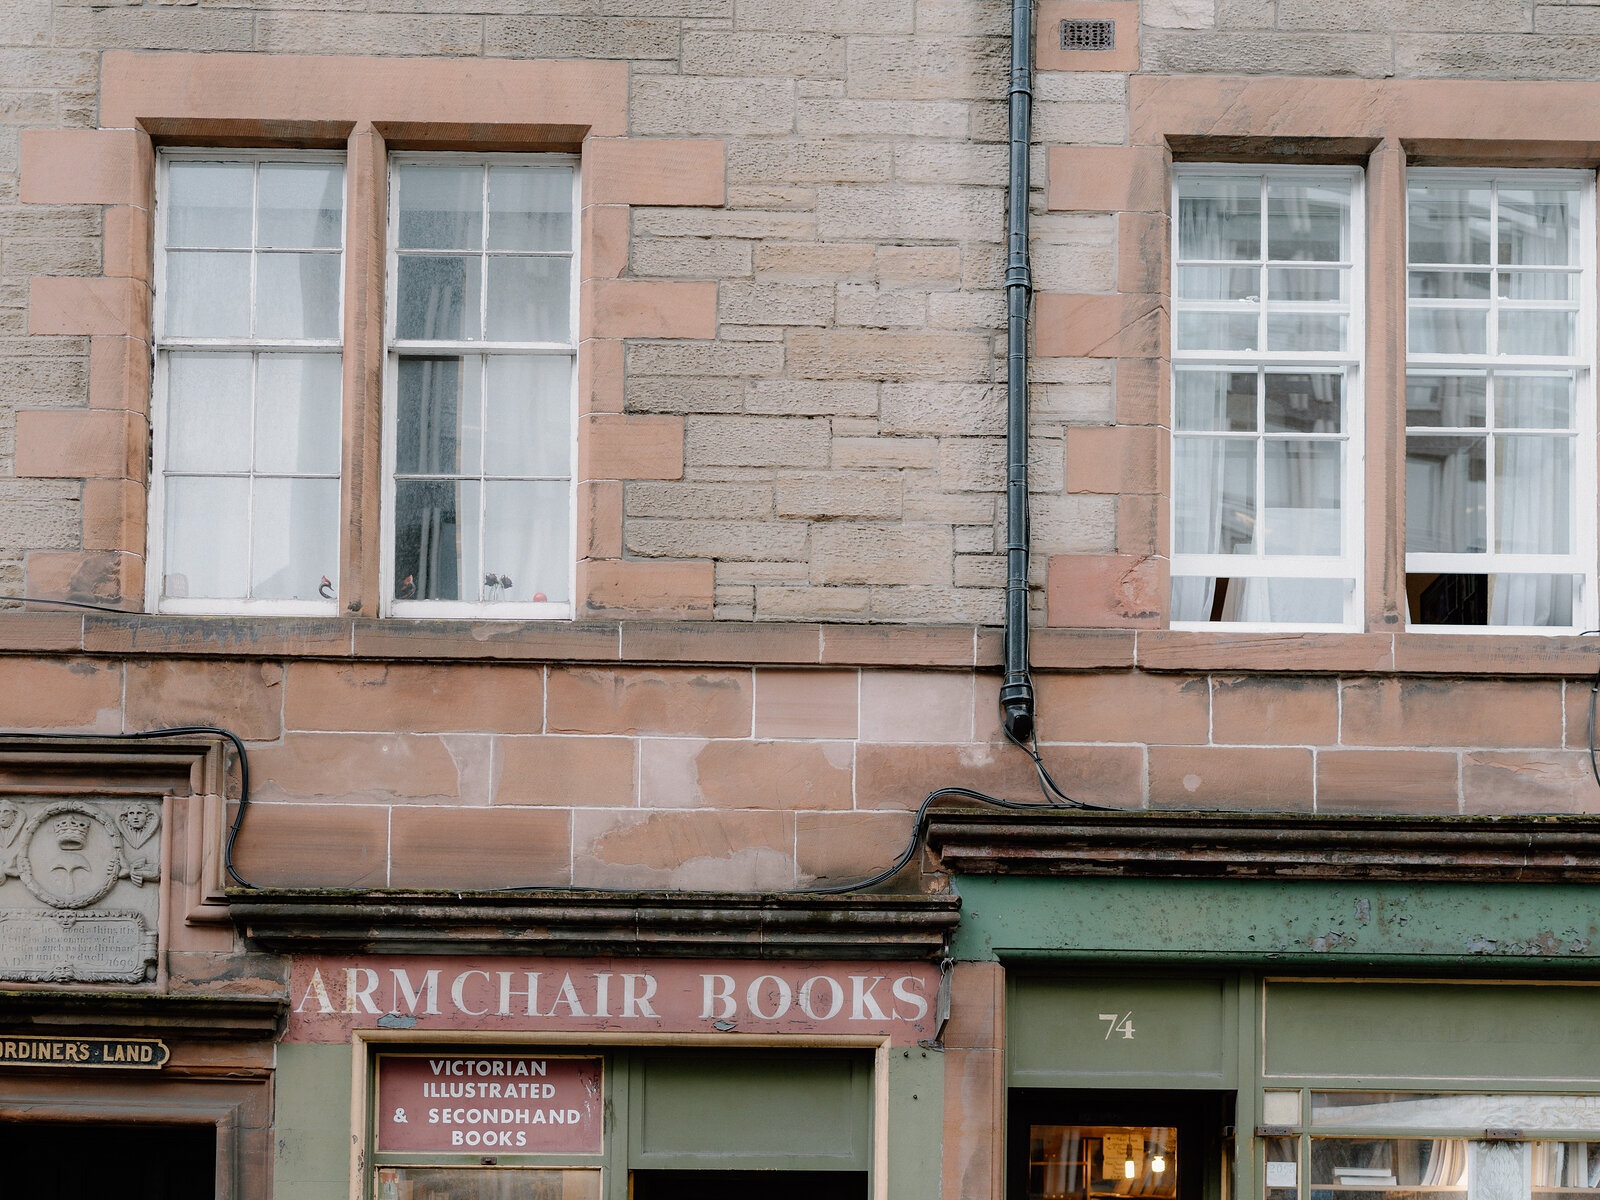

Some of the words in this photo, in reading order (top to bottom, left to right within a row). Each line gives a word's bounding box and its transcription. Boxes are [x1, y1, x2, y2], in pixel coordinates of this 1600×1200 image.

[293, 967, 661, 1018] ARMCHAIR
[698, 974, 929, 1021] BOOKS
[1099, 1011, 1136, 1040] 74
[103, 1045, 153, 1063] LAND
[429, 1060, 547, 1077] VICTORIAN
[423, 1082, 556, 1099] ILLUSTRATED
[393, 1107, 409, 1124] &
[428, 1108, 581, 1125] SECONDHAND
[451, 1131, 527, 1147] BOOKS
